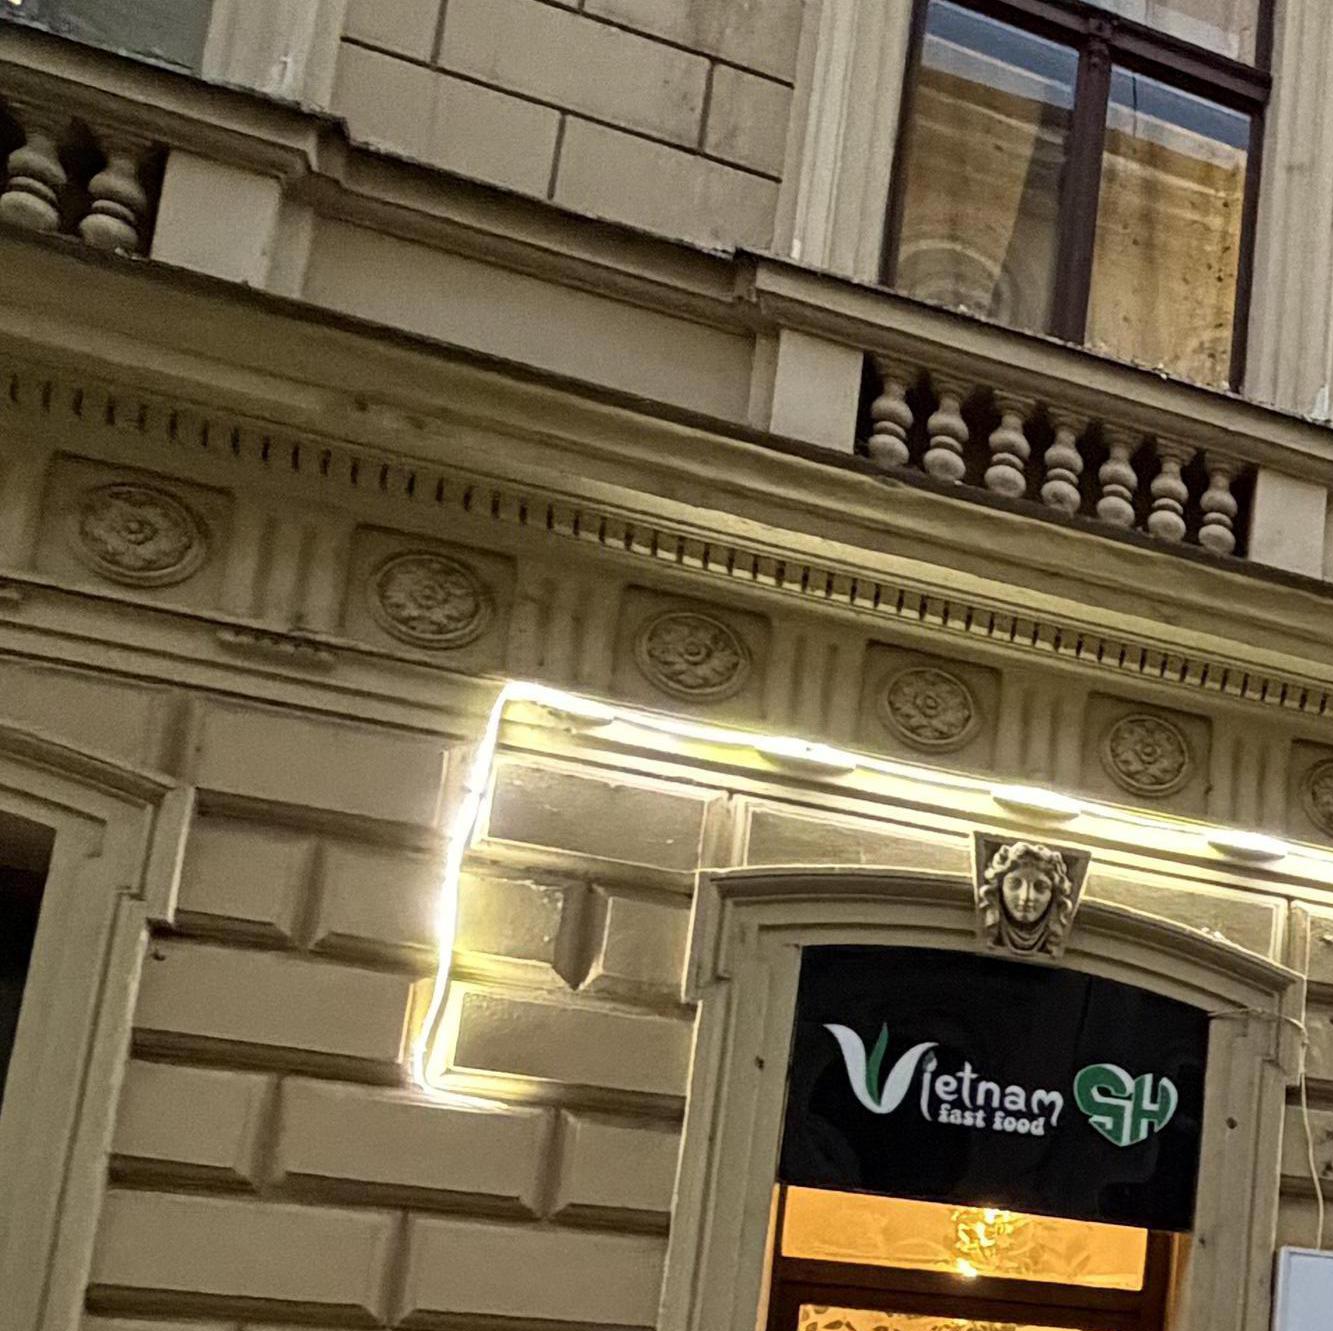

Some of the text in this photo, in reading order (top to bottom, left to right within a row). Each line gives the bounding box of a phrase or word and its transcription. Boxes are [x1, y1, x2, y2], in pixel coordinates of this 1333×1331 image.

[822, 1022, 1064, 1127] Vietnam
[938, 1104, 1045, 1136] fast food
